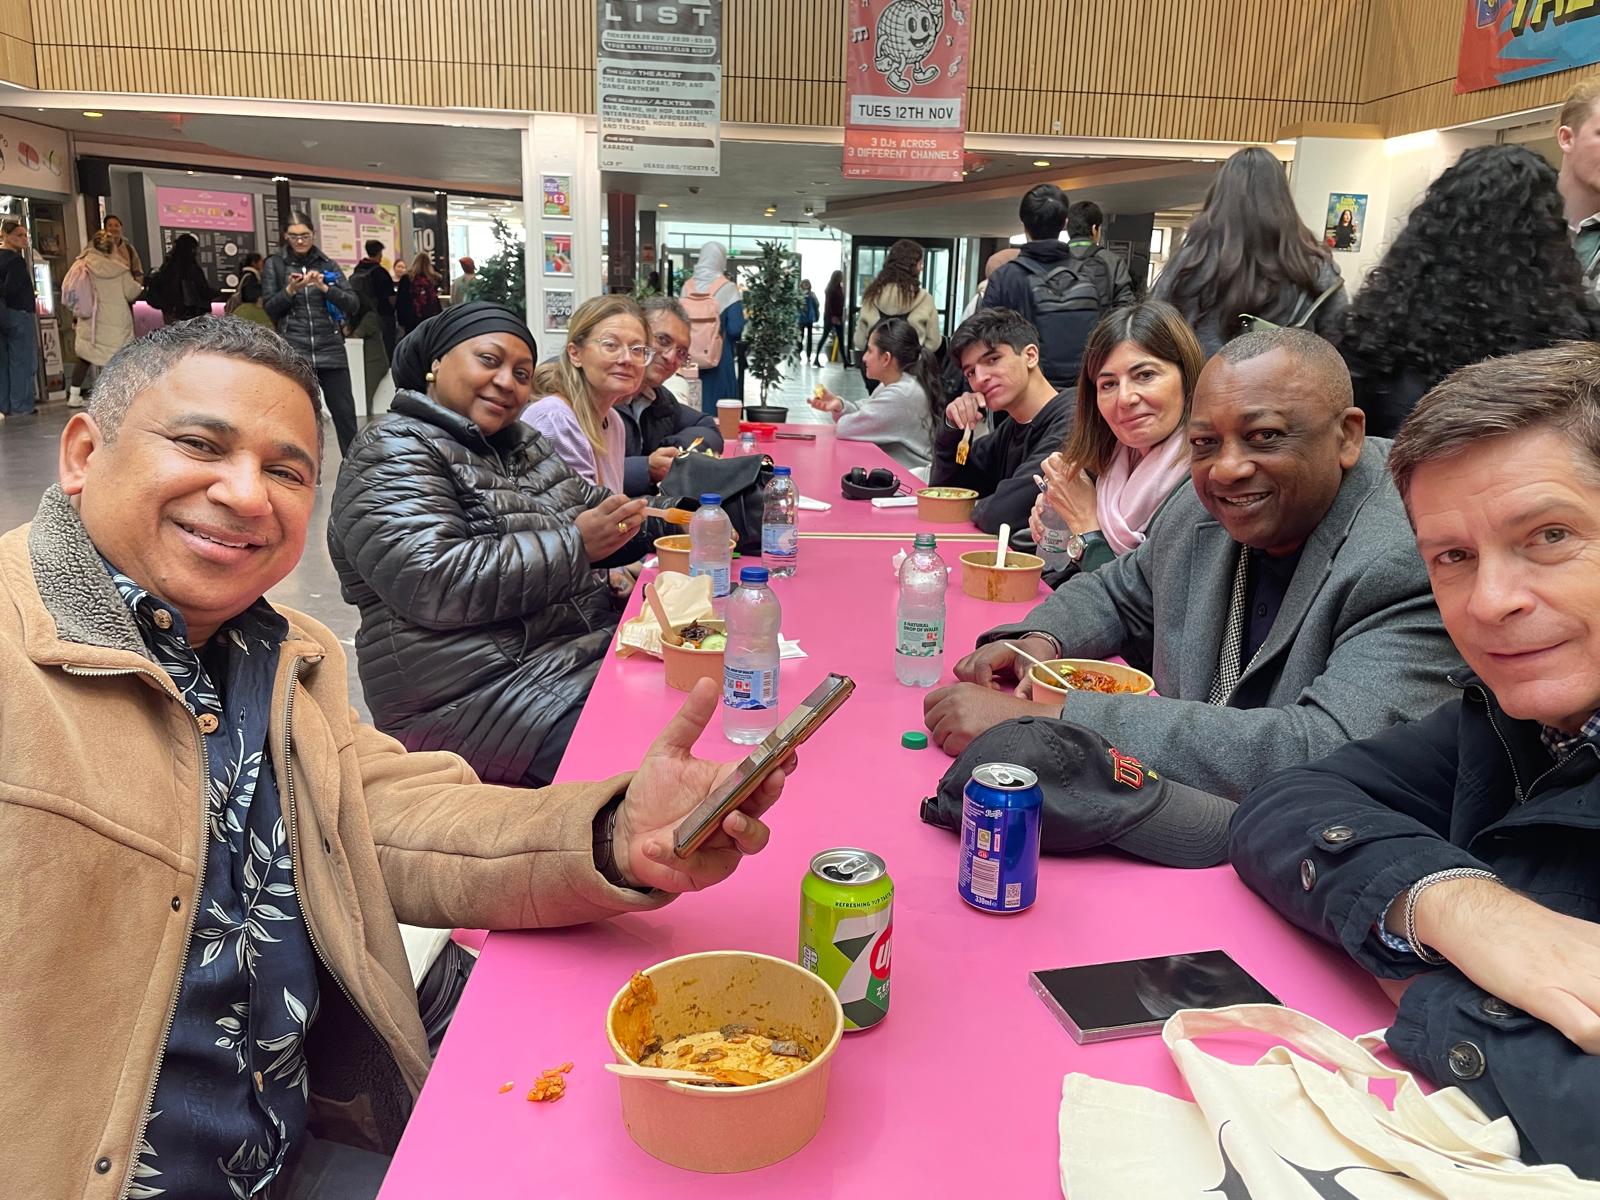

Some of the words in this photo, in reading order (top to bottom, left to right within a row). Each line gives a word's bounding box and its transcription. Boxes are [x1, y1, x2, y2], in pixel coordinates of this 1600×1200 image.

[605, 3, 712, 26] LIST
[643, 44, 672, 52] STUDENT
[617, 77, 646, 85] BIGGEST
[654, 99, 692, 107] A-EXTRA
[602, 111, 657, 120] INTERNATIONAL,
[858, 104, 891, 118] TUES
[895, 106, 924, 119] 12TH
[929, 107, 954, 120] NOV
[870, 137, 878, 147] 3
[880, 138, 897, 148] DJs
[900, 139, 937, 149] ACROSS
[847, 147, 855, 157] 3
[857, 148, 907, 159] DIFFERENT
[911, 150, 959, 160] CHANNELS
[553, 194, 565, 204] £3
[321, 203, 356, 213] BUBBLE
[357, 206, 375, 214] TEA
[547, 307, 572, 316] £5.70
[975, 894, 992, 906] 330ml
